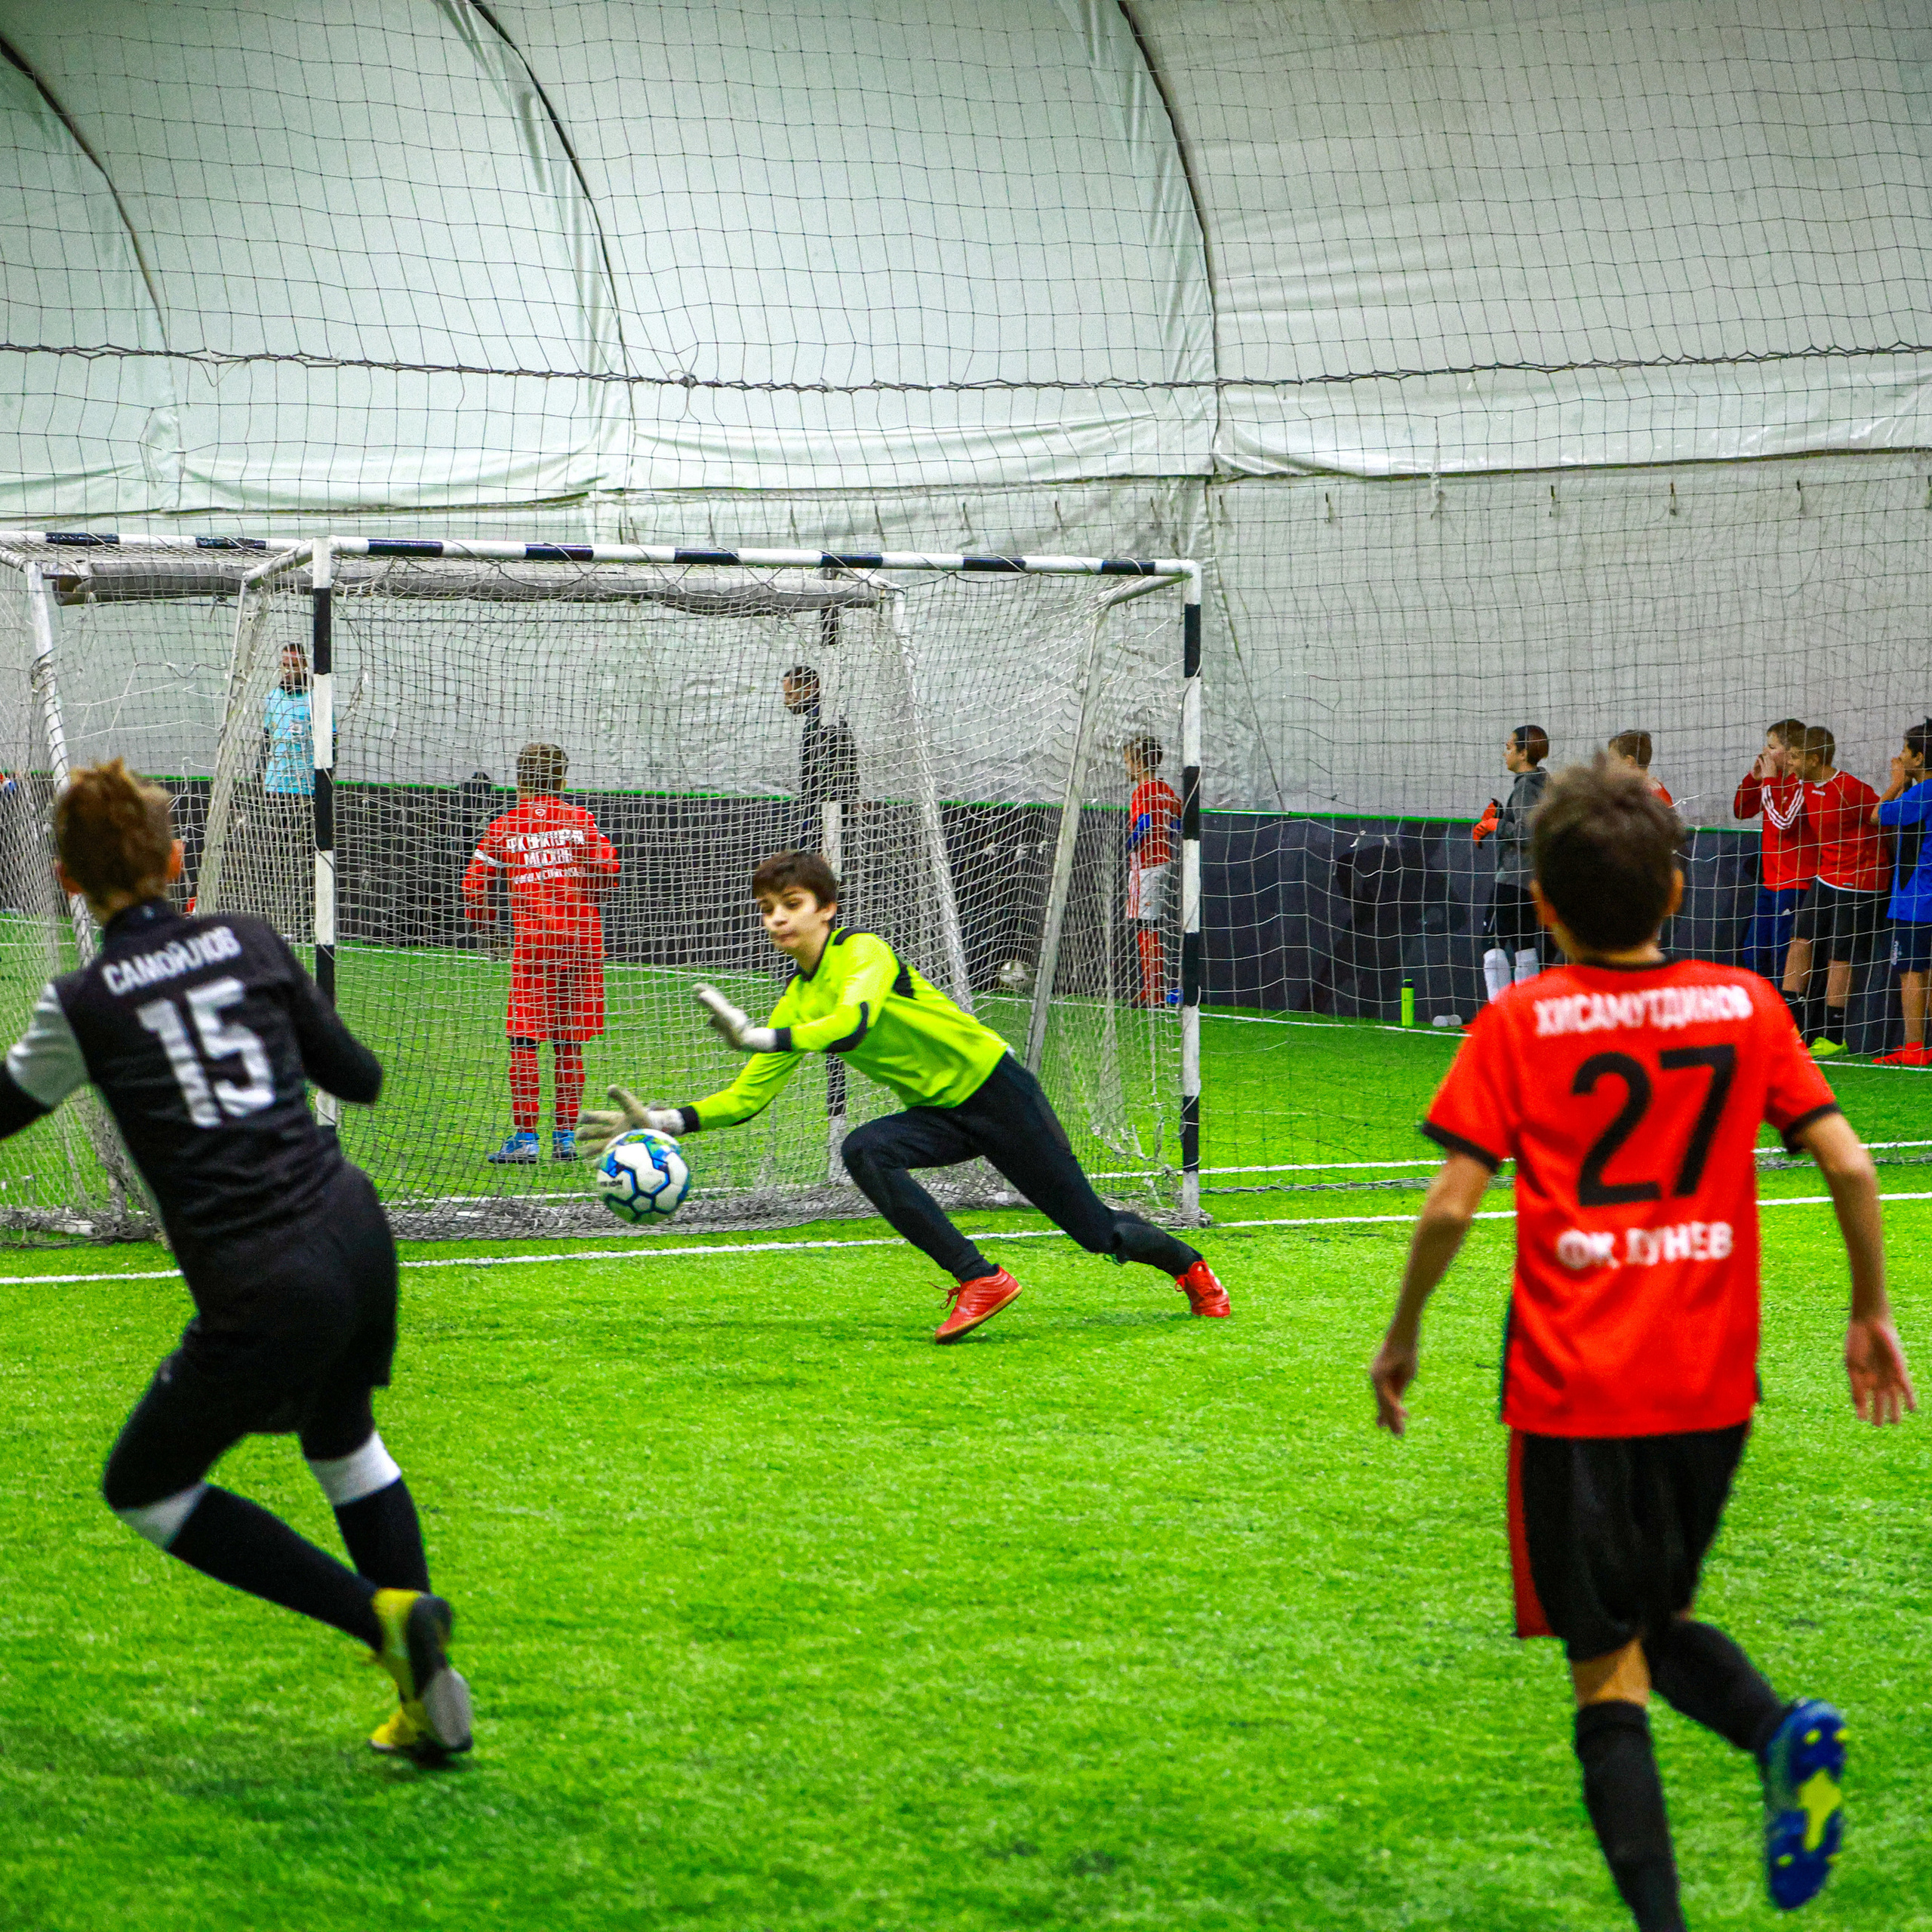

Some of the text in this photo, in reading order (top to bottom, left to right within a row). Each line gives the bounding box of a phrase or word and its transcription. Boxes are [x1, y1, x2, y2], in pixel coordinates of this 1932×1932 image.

[102, 926, 242, 996] САМОЙЛОВ
[137, 977, 275, 1128] 15
[1571, 1043, 1737, 1208] 27
